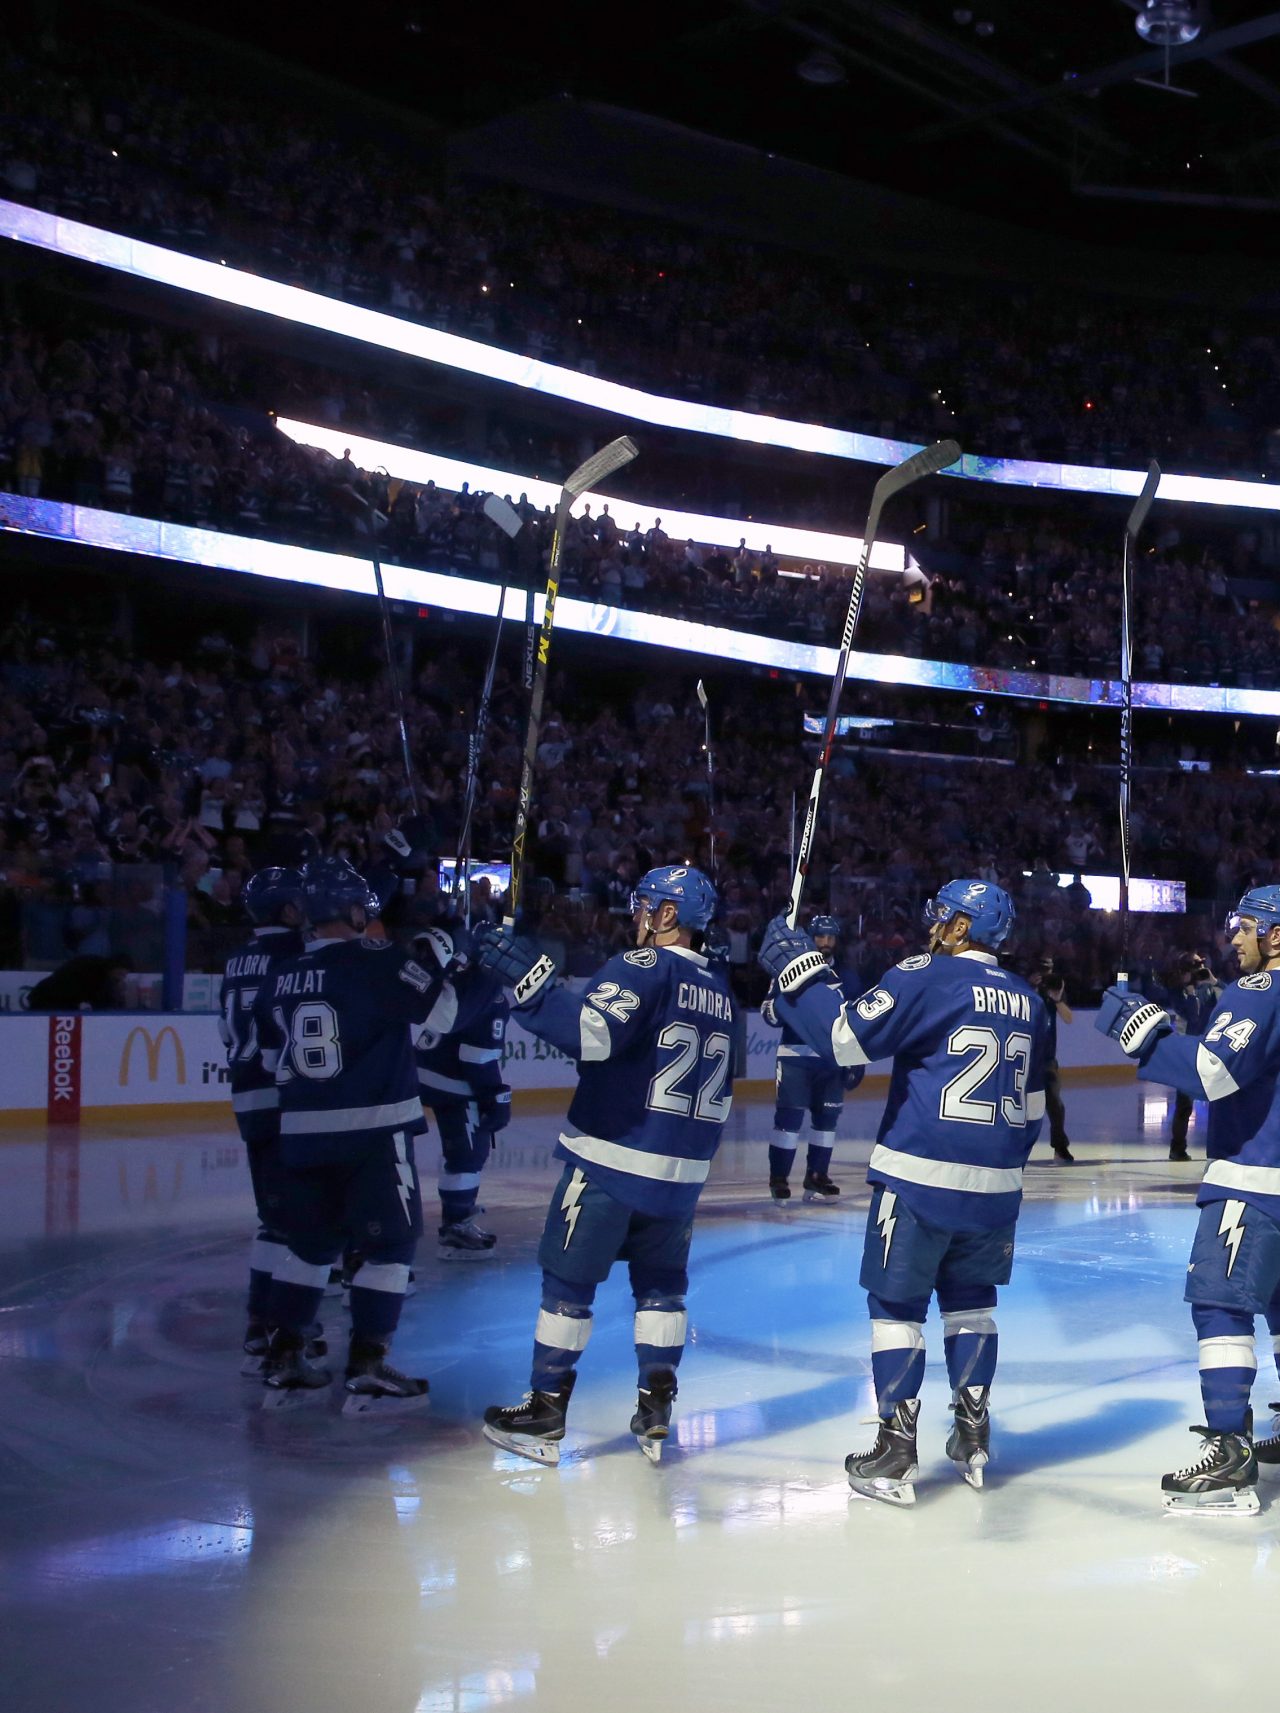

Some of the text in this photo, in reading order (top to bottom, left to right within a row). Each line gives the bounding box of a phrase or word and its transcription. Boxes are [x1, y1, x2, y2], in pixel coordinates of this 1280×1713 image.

[525, 625, 534, 689] NEXUS
[274, 969, 326, 997] PALAT
[586, 982, 640, 1023] 22
[677, 982, 733, 1022] CONDRA
[972, 986, 1031, 1022] BROWN
[1121, 1004, 1163, 1046] ARRIOR
[1205, 1012, 1258, 1053] 24
[54, 1015, 76, 1102] Reebok
[645, 1021, 731, 1124] 22
[942, 1025, 1032, 1128] 23
